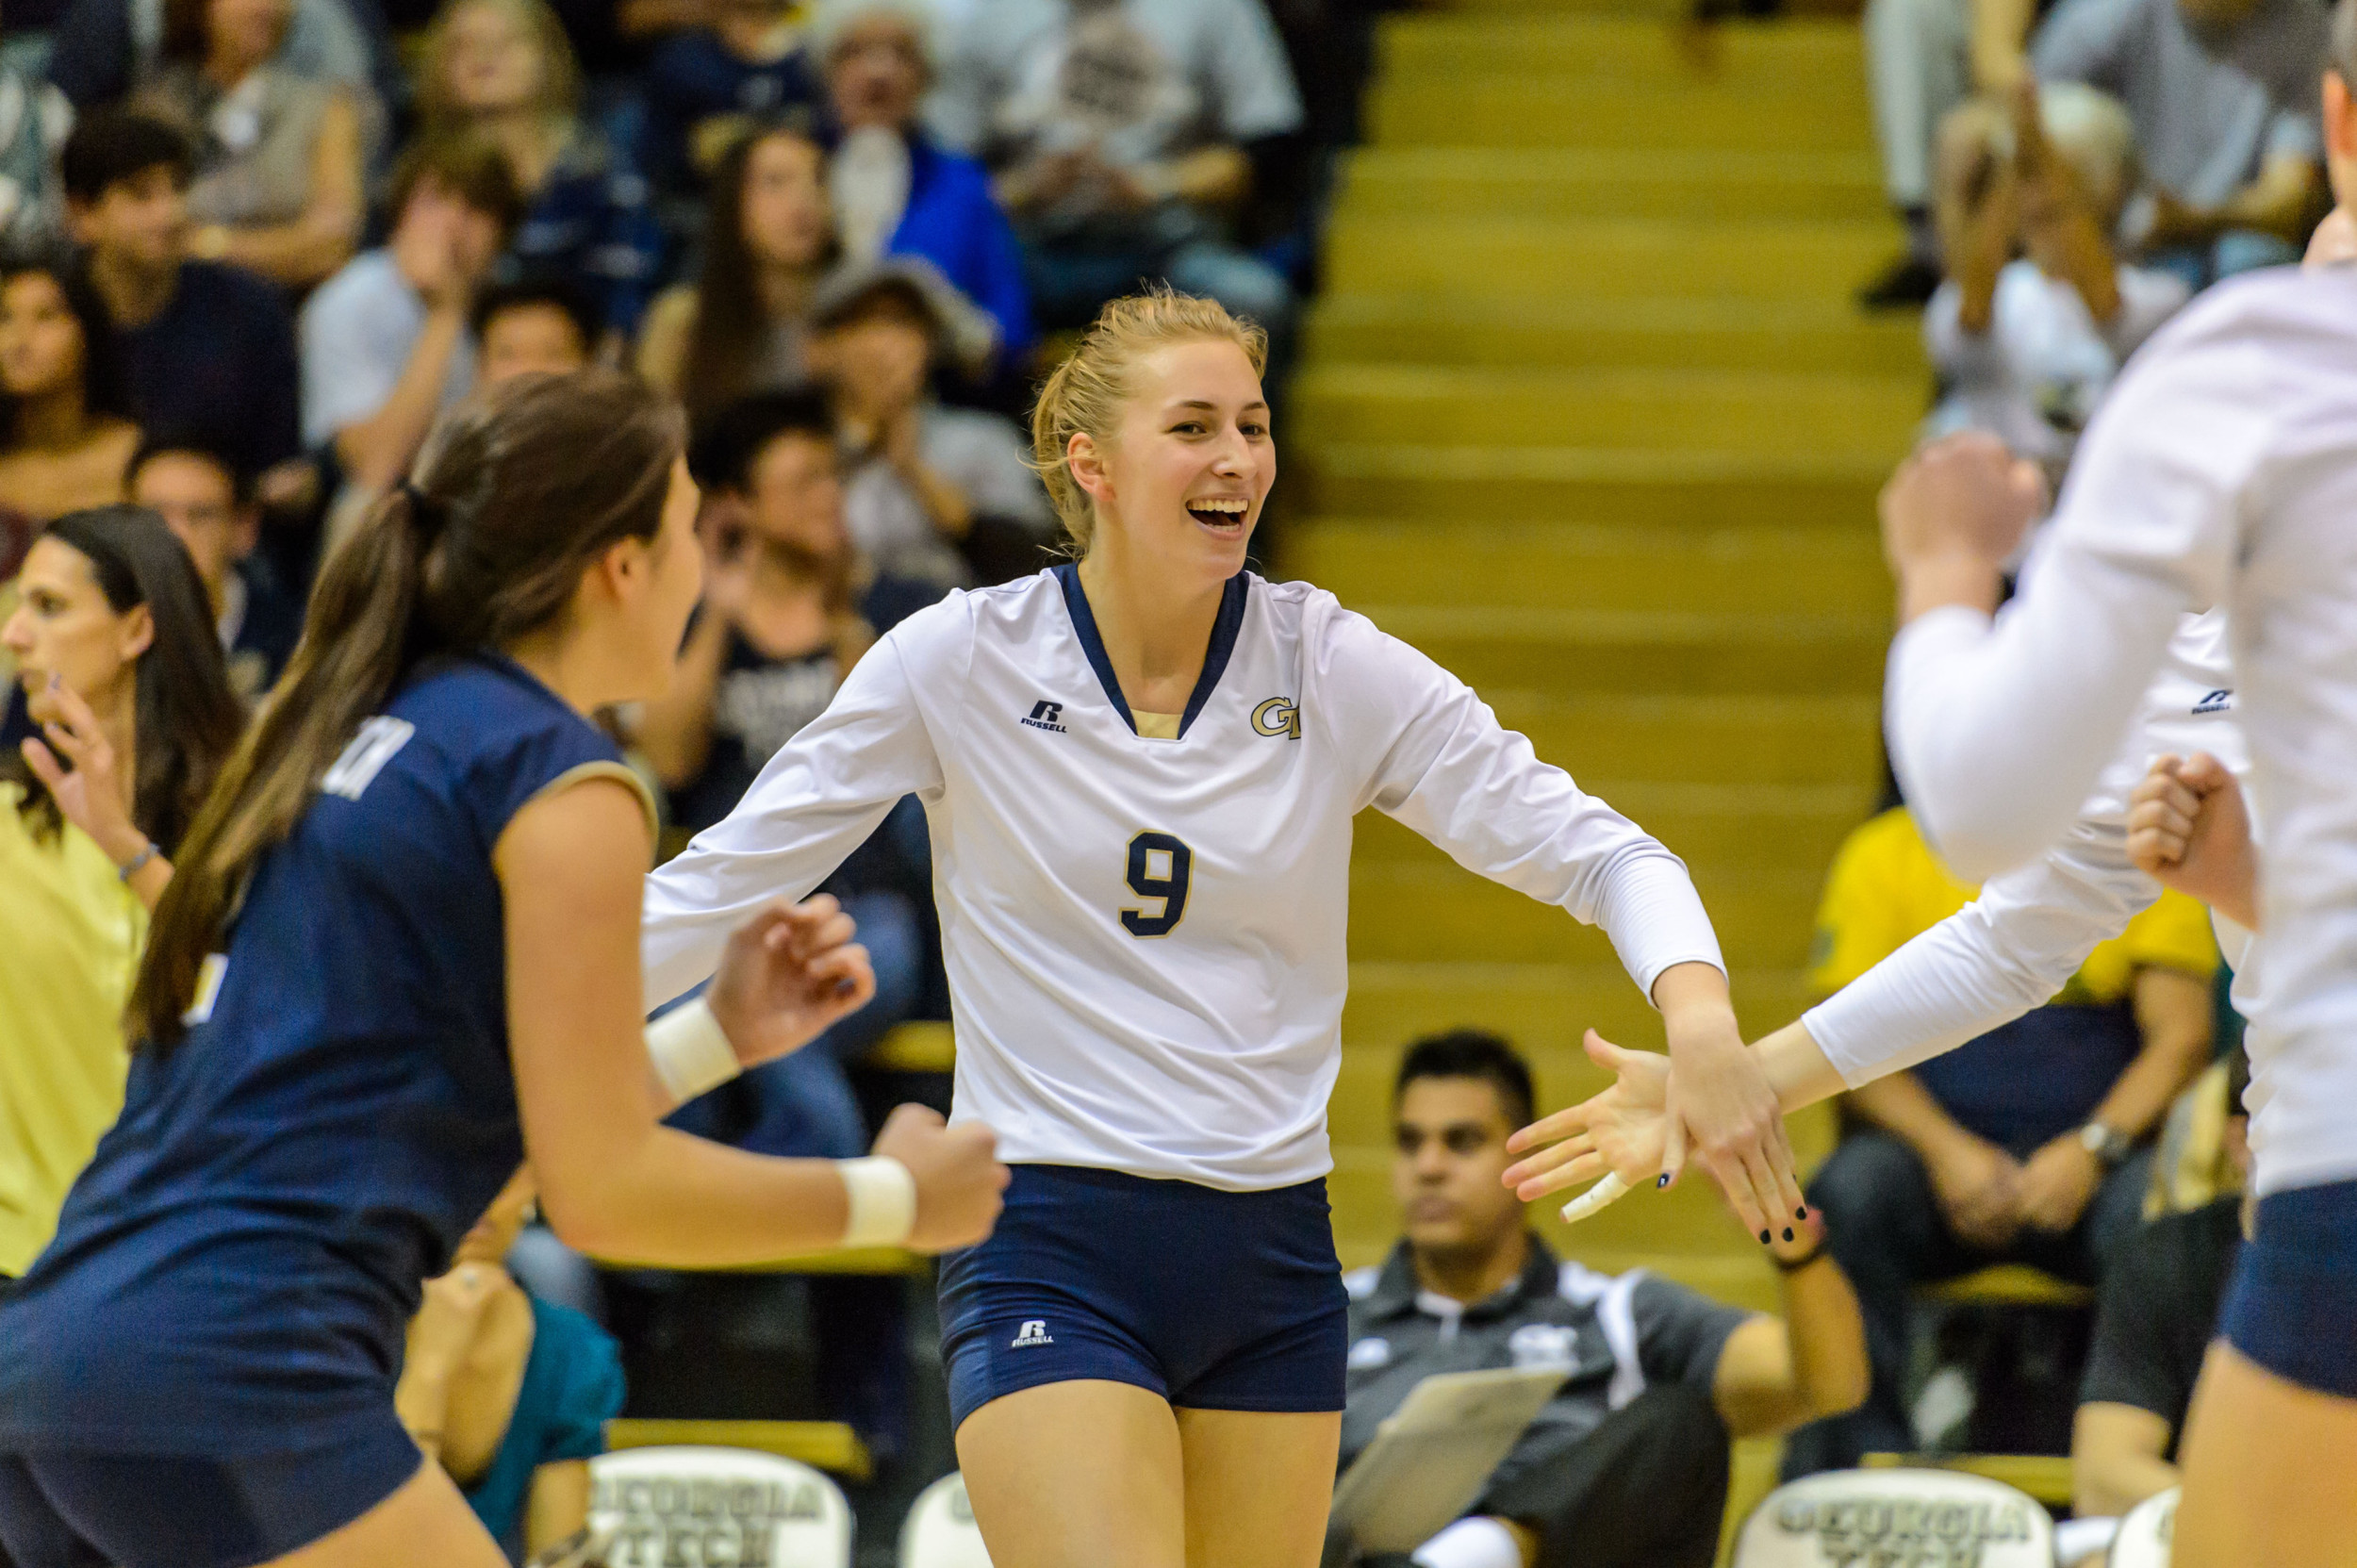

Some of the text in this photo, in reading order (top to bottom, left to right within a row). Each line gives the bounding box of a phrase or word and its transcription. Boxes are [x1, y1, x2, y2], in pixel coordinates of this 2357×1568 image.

[1020, 718, 1067, 734] RUSSELL
[1117, 828, 1195, 940] 9
[1011, 1335, 1054, 1348] RUSSELL
[1776, 1495, 2031, 1544] GEORGIA
